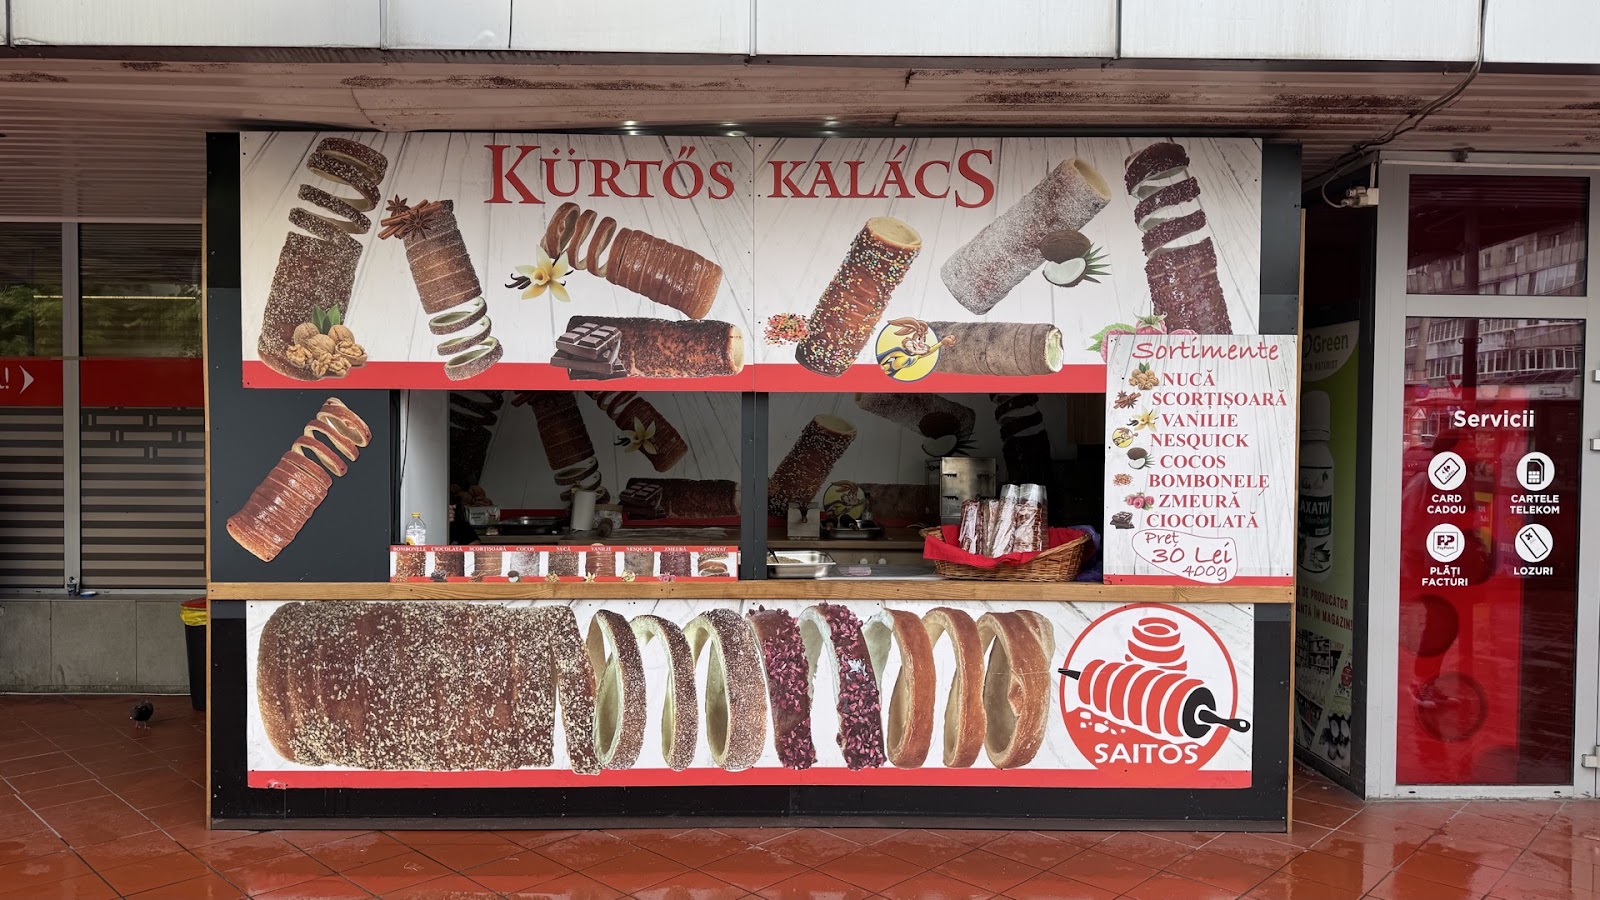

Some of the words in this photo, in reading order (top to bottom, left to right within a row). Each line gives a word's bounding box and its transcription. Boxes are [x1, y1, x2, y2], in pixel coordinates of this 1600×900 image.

[484, 144, 735, 204] KÜRTŐS
[767, 144, 996, 209] KALÁCS
[1132, 337, 1279, 361] Sortimente
[1313, 334, 1349, 353] Green
[1162, 369, 1215, 386] NUCĂ
[1152, 389, 1287, 410] SCORȚIȘOARĂ
[1162, 413, 1238, 427] VANILIE
[1453, 410, 1535, 428] Servicii
[1150, 433, 1250, 450] NESQUICK
[1160, 454, 1226, 469] COCOS
[1149, 474, 1270, 489] BOMBONELE
[1158, 491, 1241, 509] ZMEURĂ
[1431, 494, 1462, 504] CARD
[1510, 494, 1560, 504] CARTELE
[1300, 500, 1331, 515] AXATIV
[1427, 505, 1466, 514] CADOU
[1509, 505, 1560, 514] TELEKOM
[1146, 512, 1259, 528] CIOCOLATĂ
[1145, 532, 1179, 548] Preț
[1151, 547, 1185, 563] 30
[1195, 542, 1232, 564] Lei
[1182, 565, 1228, 581] 400g
[1430, 565, 1461, 577] PLĂȚI
[1513, 567, 1553, 576] LOZURI
[1421, 577, 1468, 587] FACTURI
[1094, 742, 1199, 765] SAITOS
